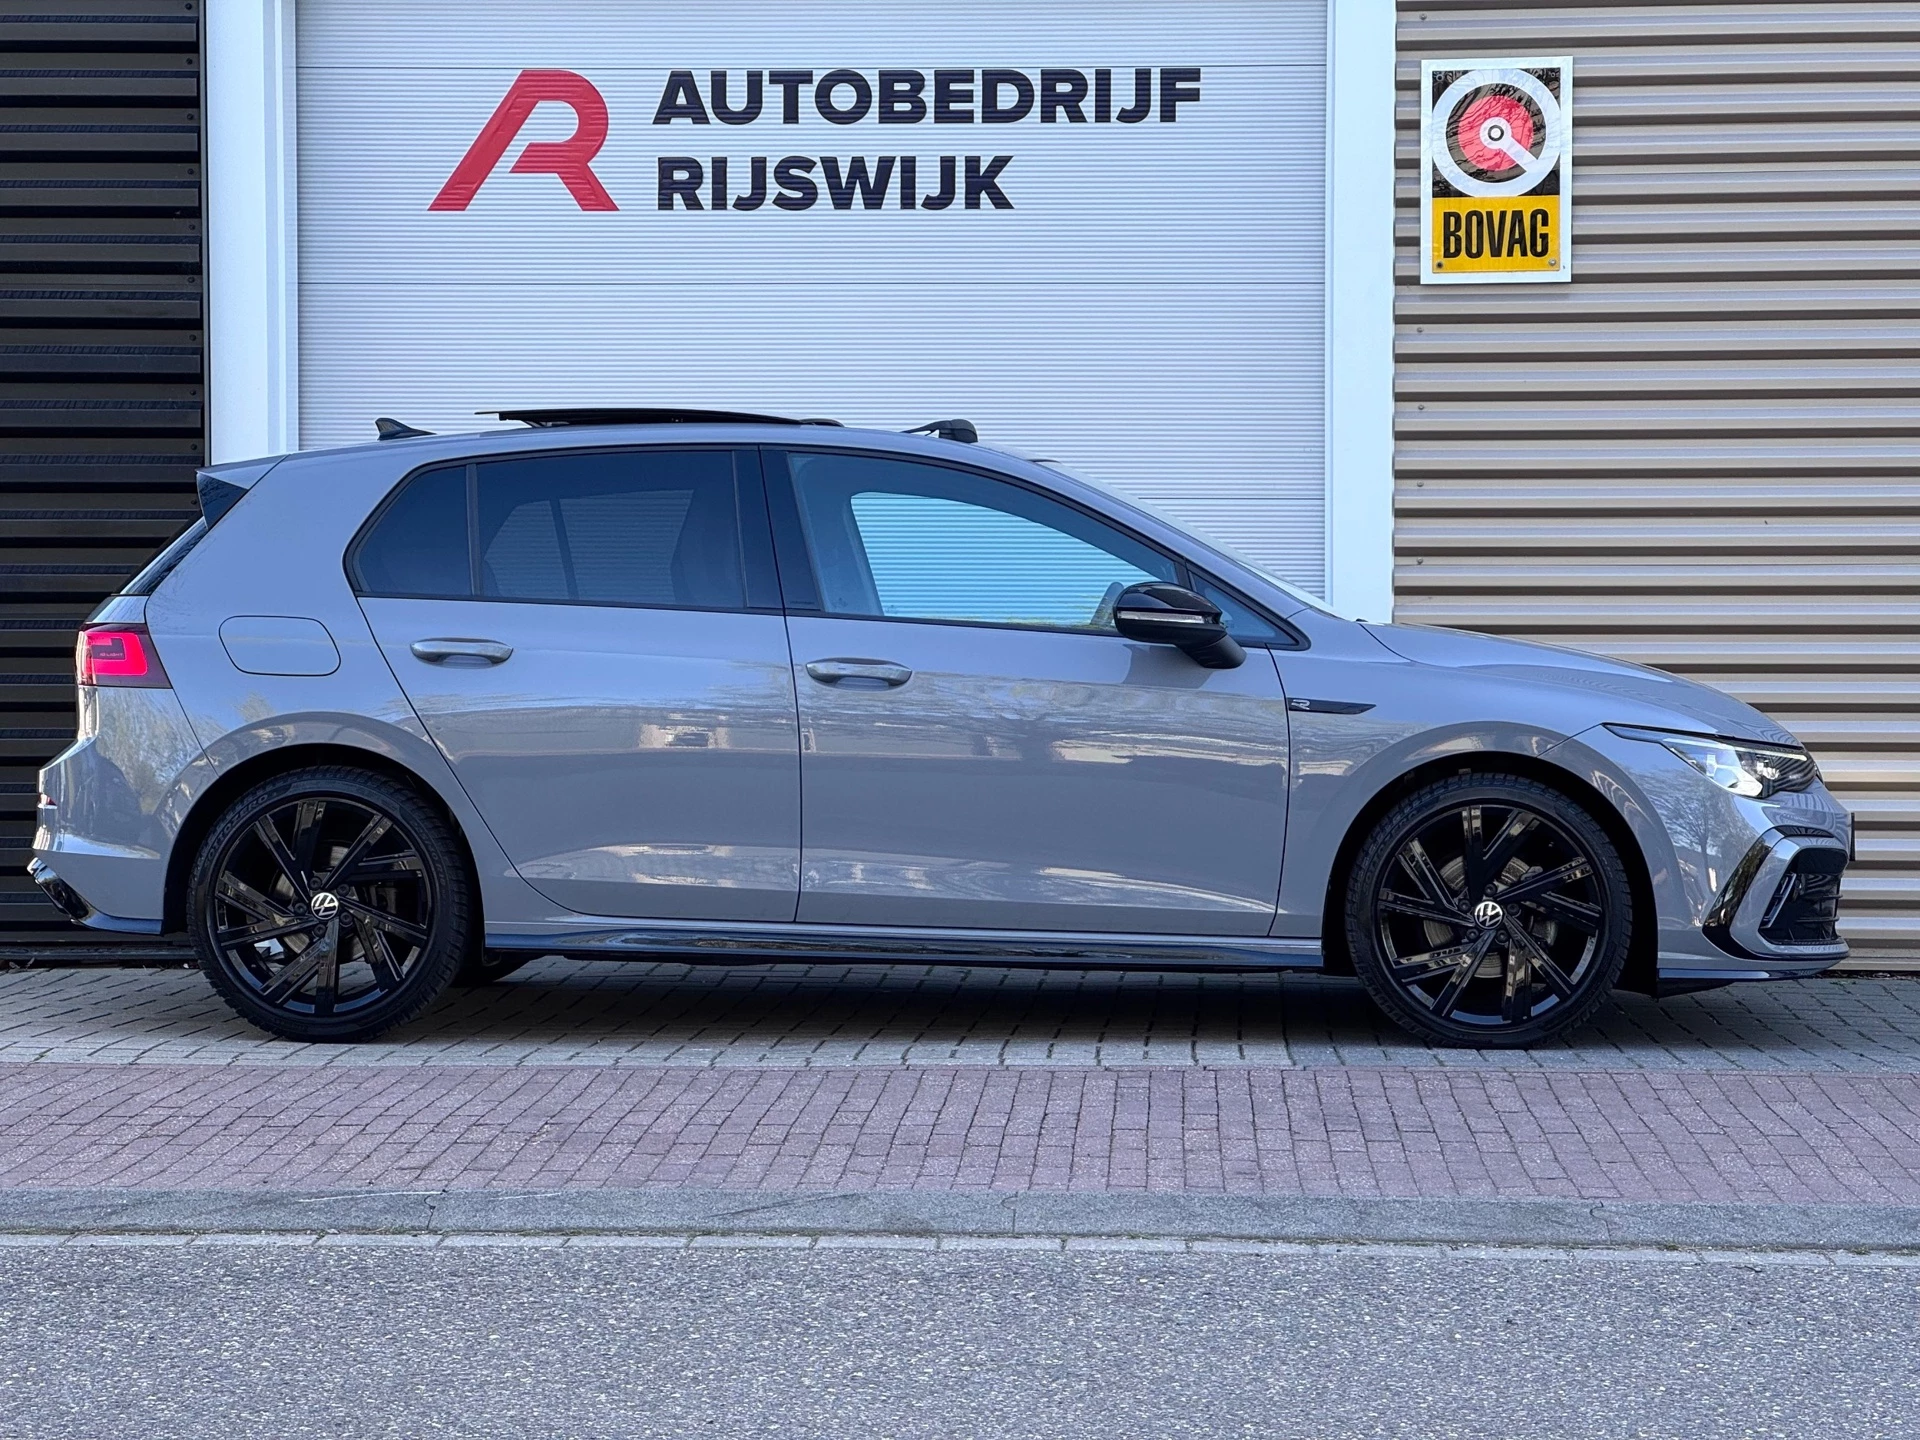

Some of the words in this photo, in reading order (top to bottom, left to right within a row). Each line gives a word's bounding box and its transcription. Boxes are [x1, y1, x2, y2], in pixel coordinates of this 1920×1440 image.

[652, 67, 1202, 126] AUTOBEDRIJF
[657, 155, 1014, 211] RIJSWIJK
[1443, 208, 1549, 259] BOVAG
[1291, 699, 1311, 710] R
